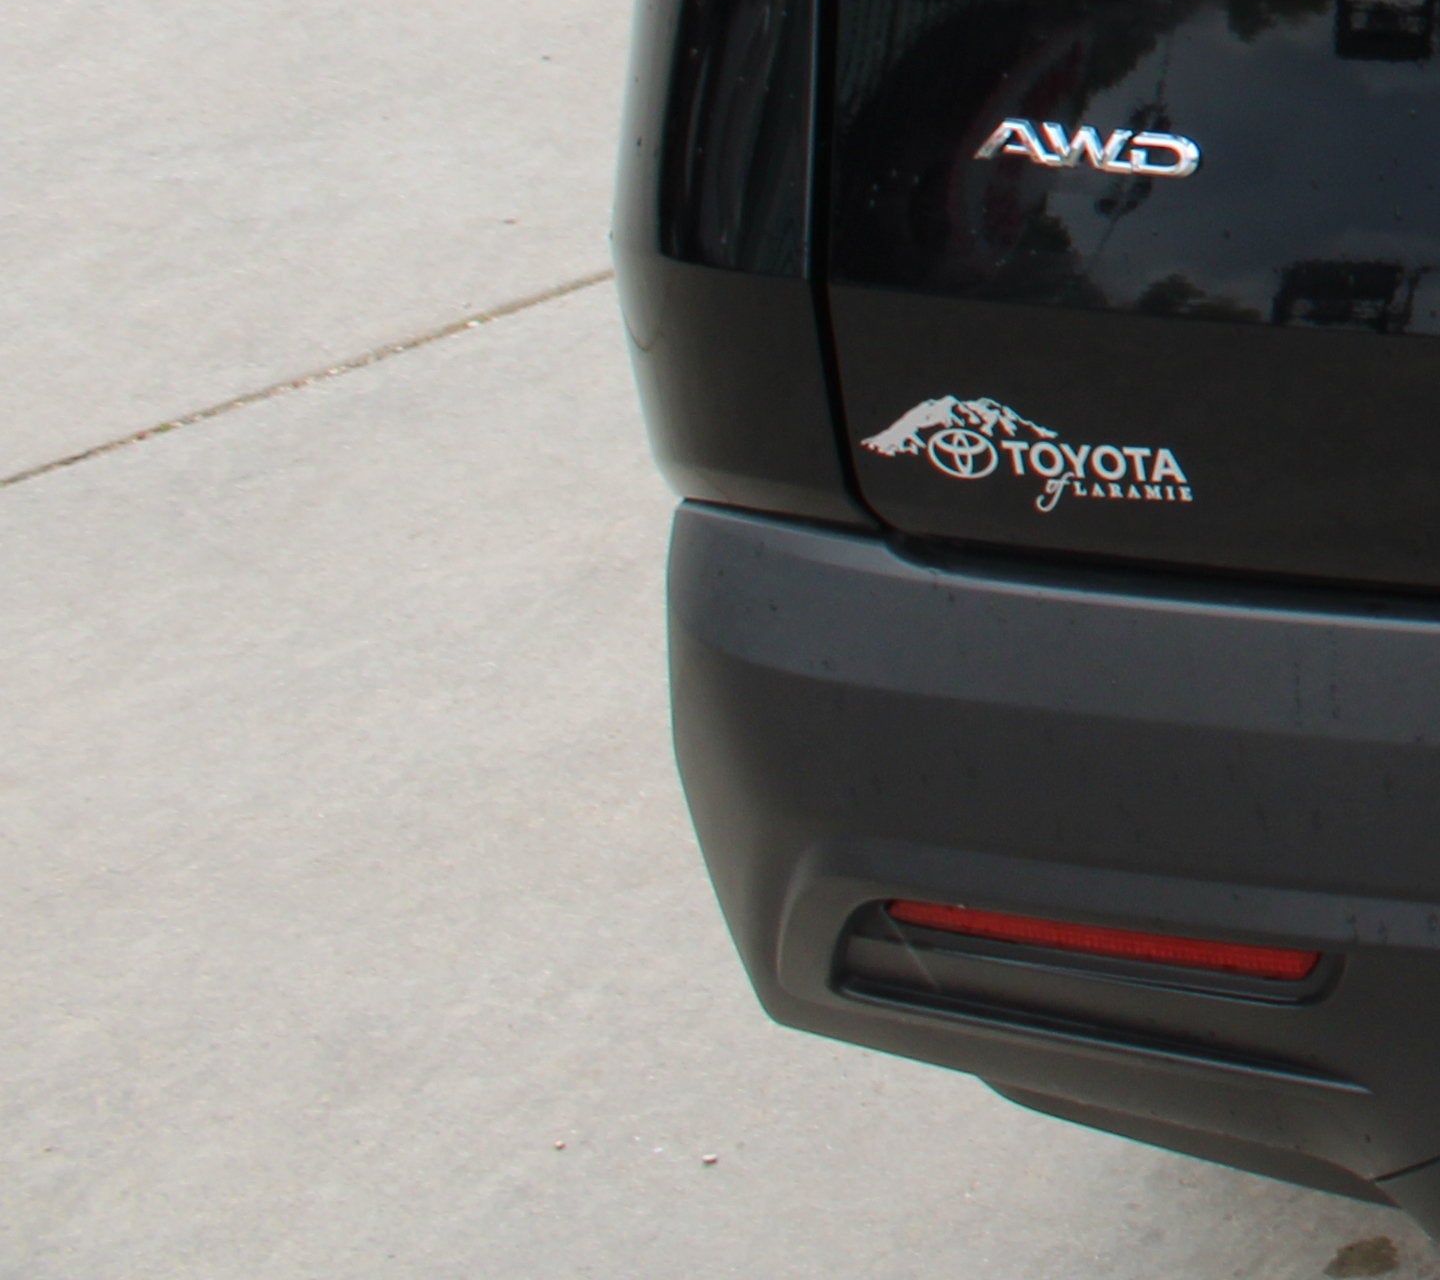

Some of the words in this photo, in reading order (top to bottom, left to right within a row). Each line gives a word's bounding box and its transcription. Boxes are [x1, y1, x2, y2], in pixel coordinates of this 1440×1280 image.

[973, 116, 1202, 178] AWD
[1001, 440, 1188, 484] TOYOTA
[1035, 472, 1076, 512] of
[1073, 480, 1193, 503] LARAMIE
